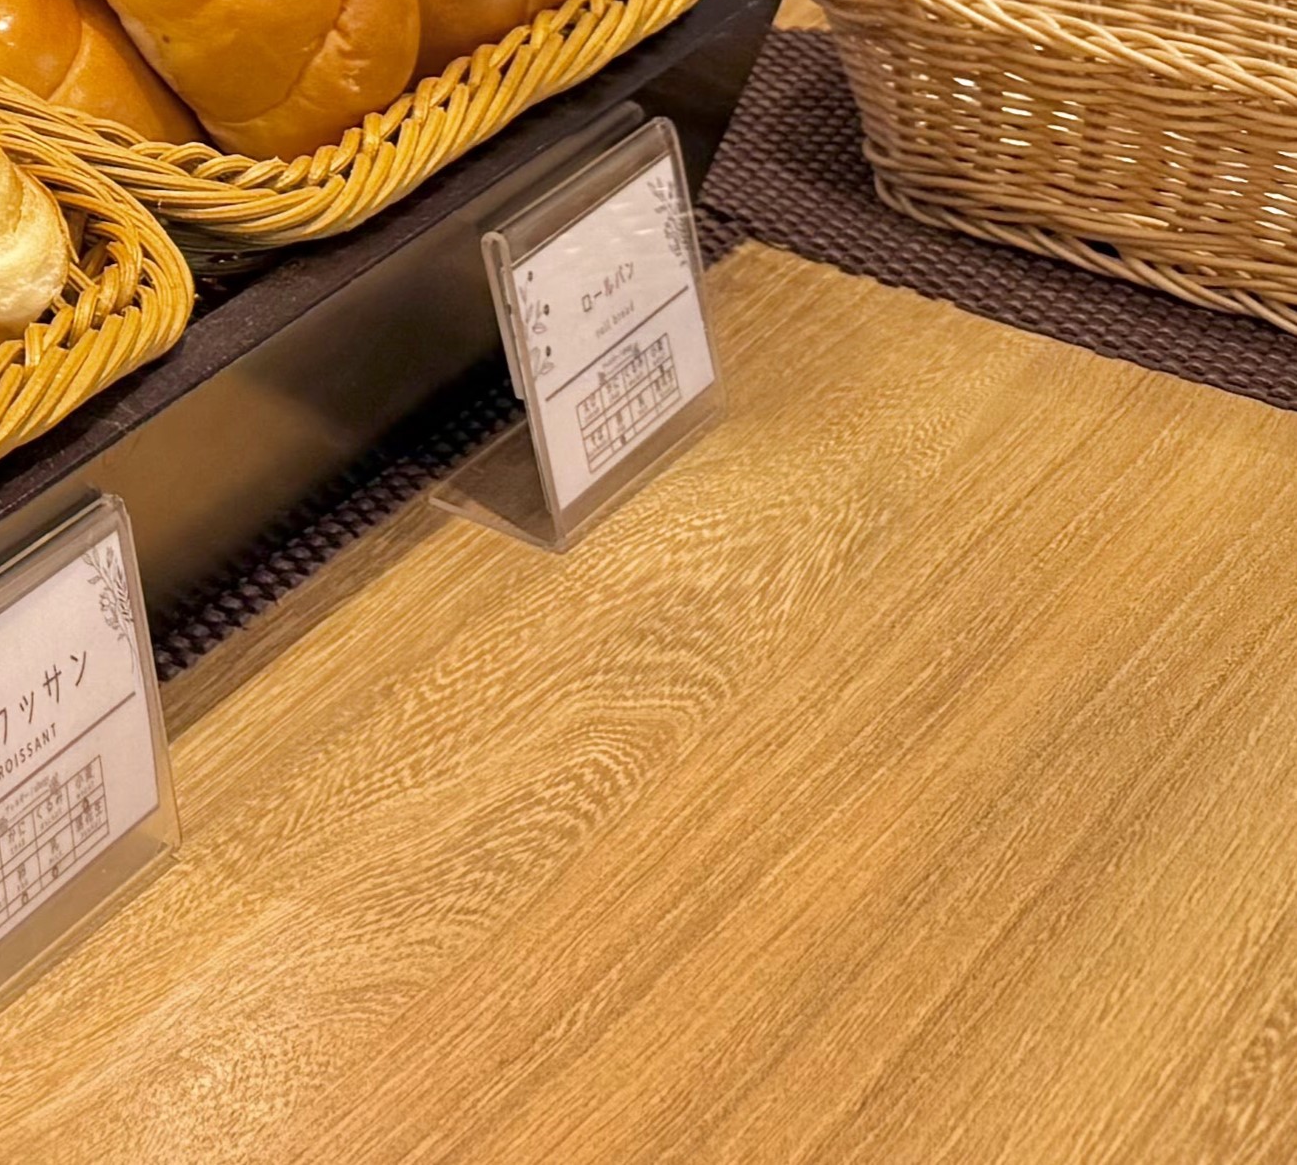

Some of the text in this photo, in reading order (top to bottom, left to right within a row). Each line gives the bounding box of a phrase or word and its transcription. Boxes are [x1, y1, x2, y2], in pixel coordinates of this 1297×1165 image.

[581, 261, 634, 312] ロールパン
